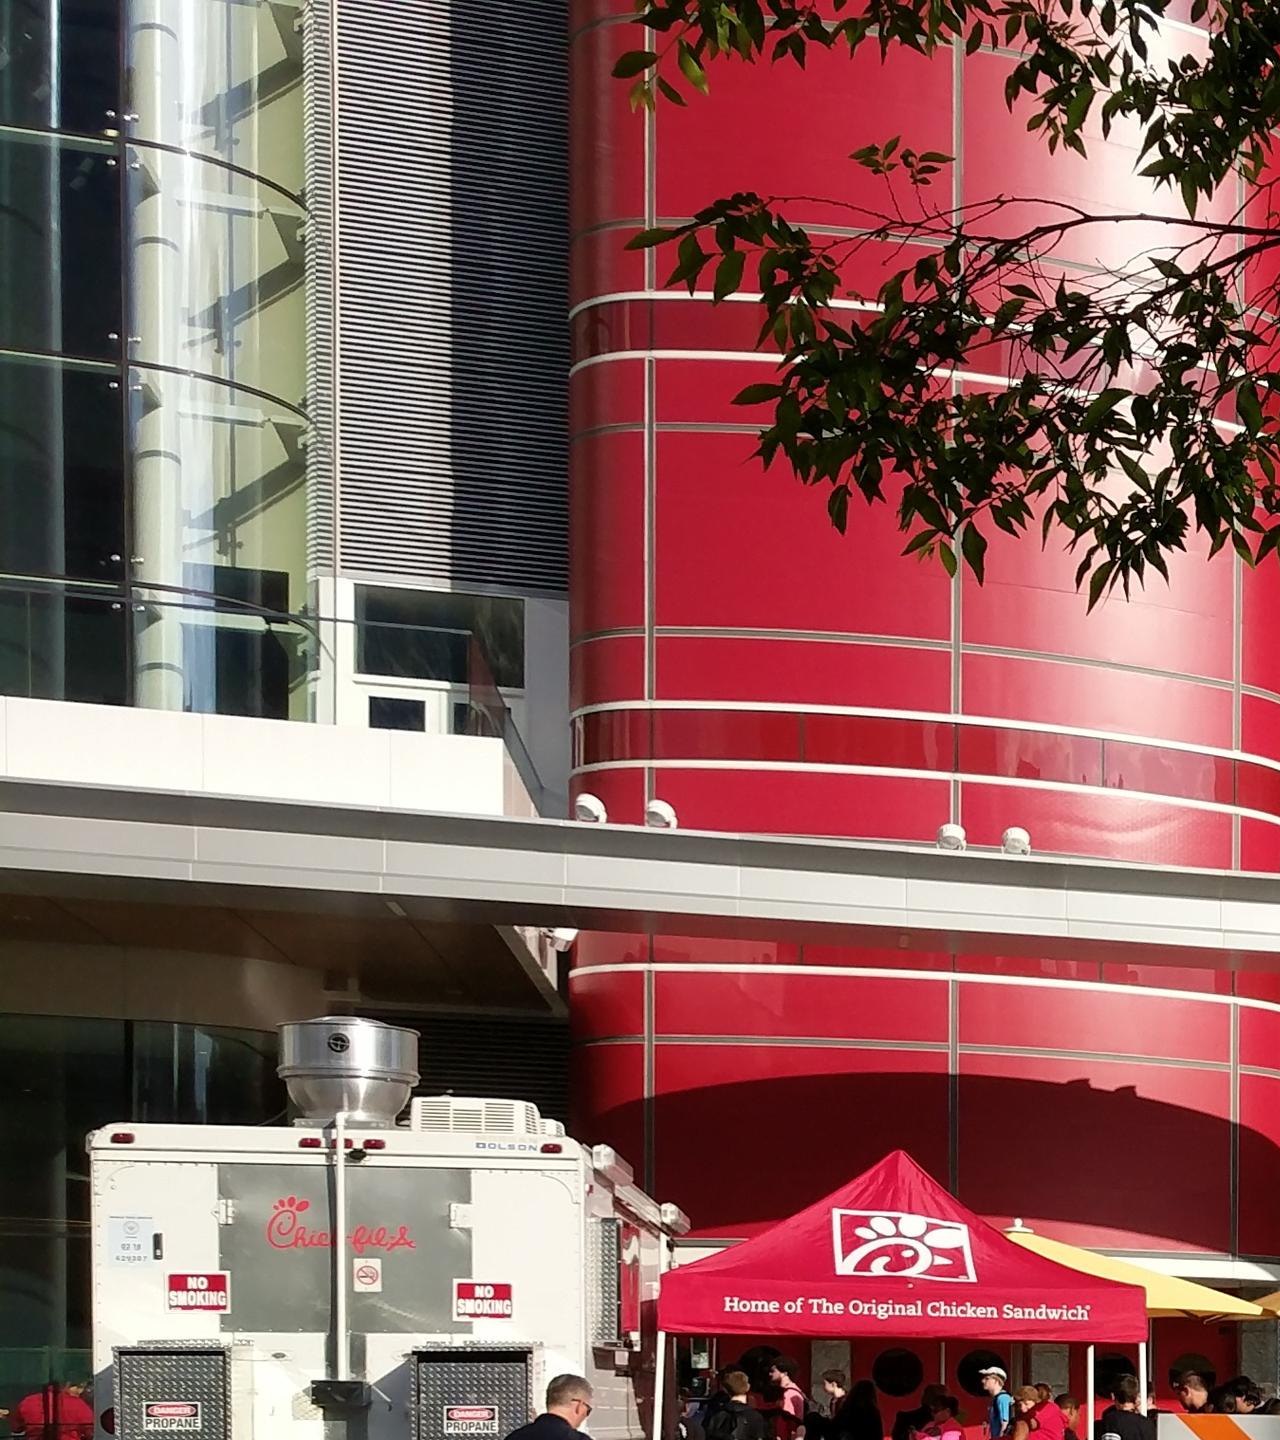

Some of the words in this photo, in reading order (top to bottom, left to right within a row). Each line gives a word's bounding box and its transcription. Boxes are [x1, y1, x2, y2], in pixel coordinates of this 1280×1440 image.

[187, 1276, 208, 1290] NO
[169, 1290, 227, 1306] SMOKING
[474, 1285, 494, 1298] NO
[457, 1299, 512, 1314] SMOKING
[723, 1296, 780, 1313] Home
[784, 1297, 805, 1314] of
[808, 1298, 844, 1315] The
[848, 1299, 923, 1320] Original
[927, 1301, 998, 1319] Chicken
[453, 1409, 489, 1419] DANGER
[145, 1417, 200, 1429] PROPANE
[446, 1422, 497, 1432] PROPANE
